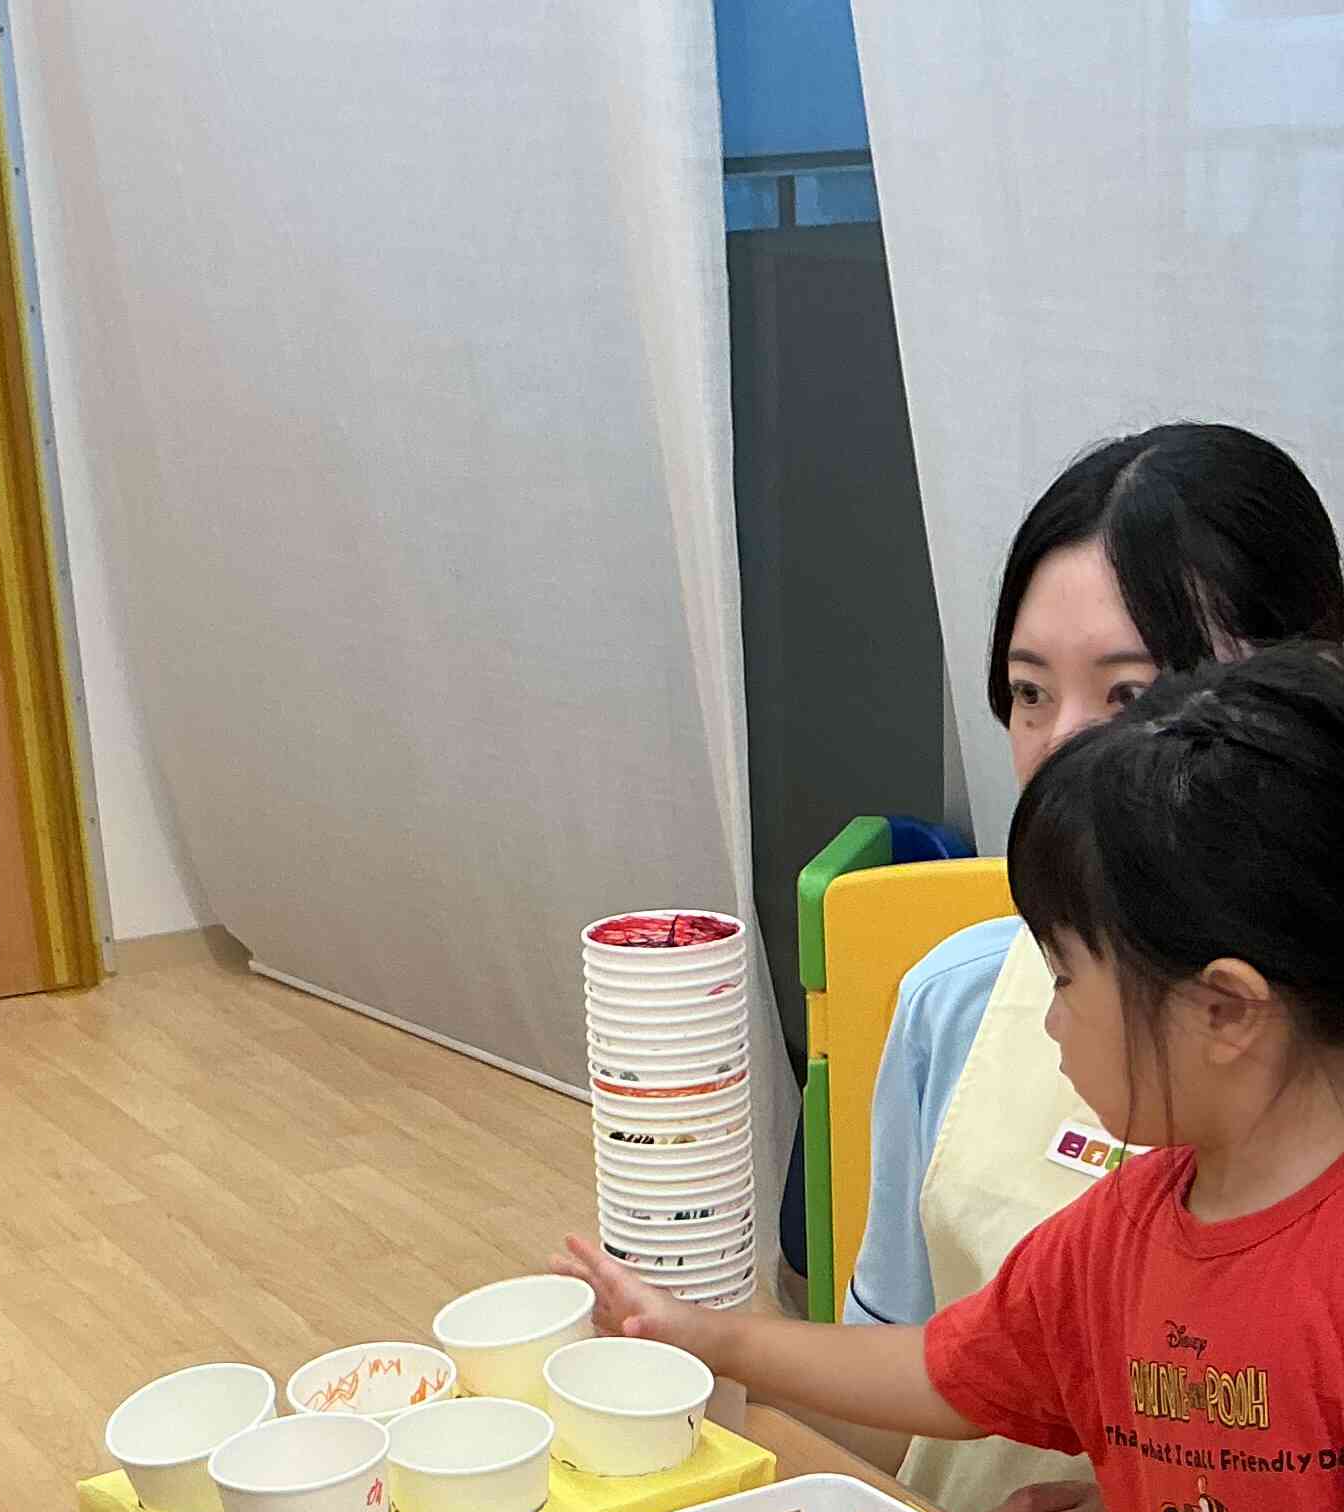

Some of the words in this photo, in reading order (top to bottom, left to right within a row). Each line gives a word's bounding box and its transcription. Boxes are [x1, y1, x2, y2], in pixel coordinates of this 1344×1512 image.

[1165, 1319, 1208, 1360] Disney
[1205, 1366, 1270, 1431] POOH
[1141, 1440, 1174, 1466] what
[1174, 1445, 1183, 1468] I
[1185, 1448, 1216, 1471] call
[1220, 1449, 1313, 1475] Friendly
